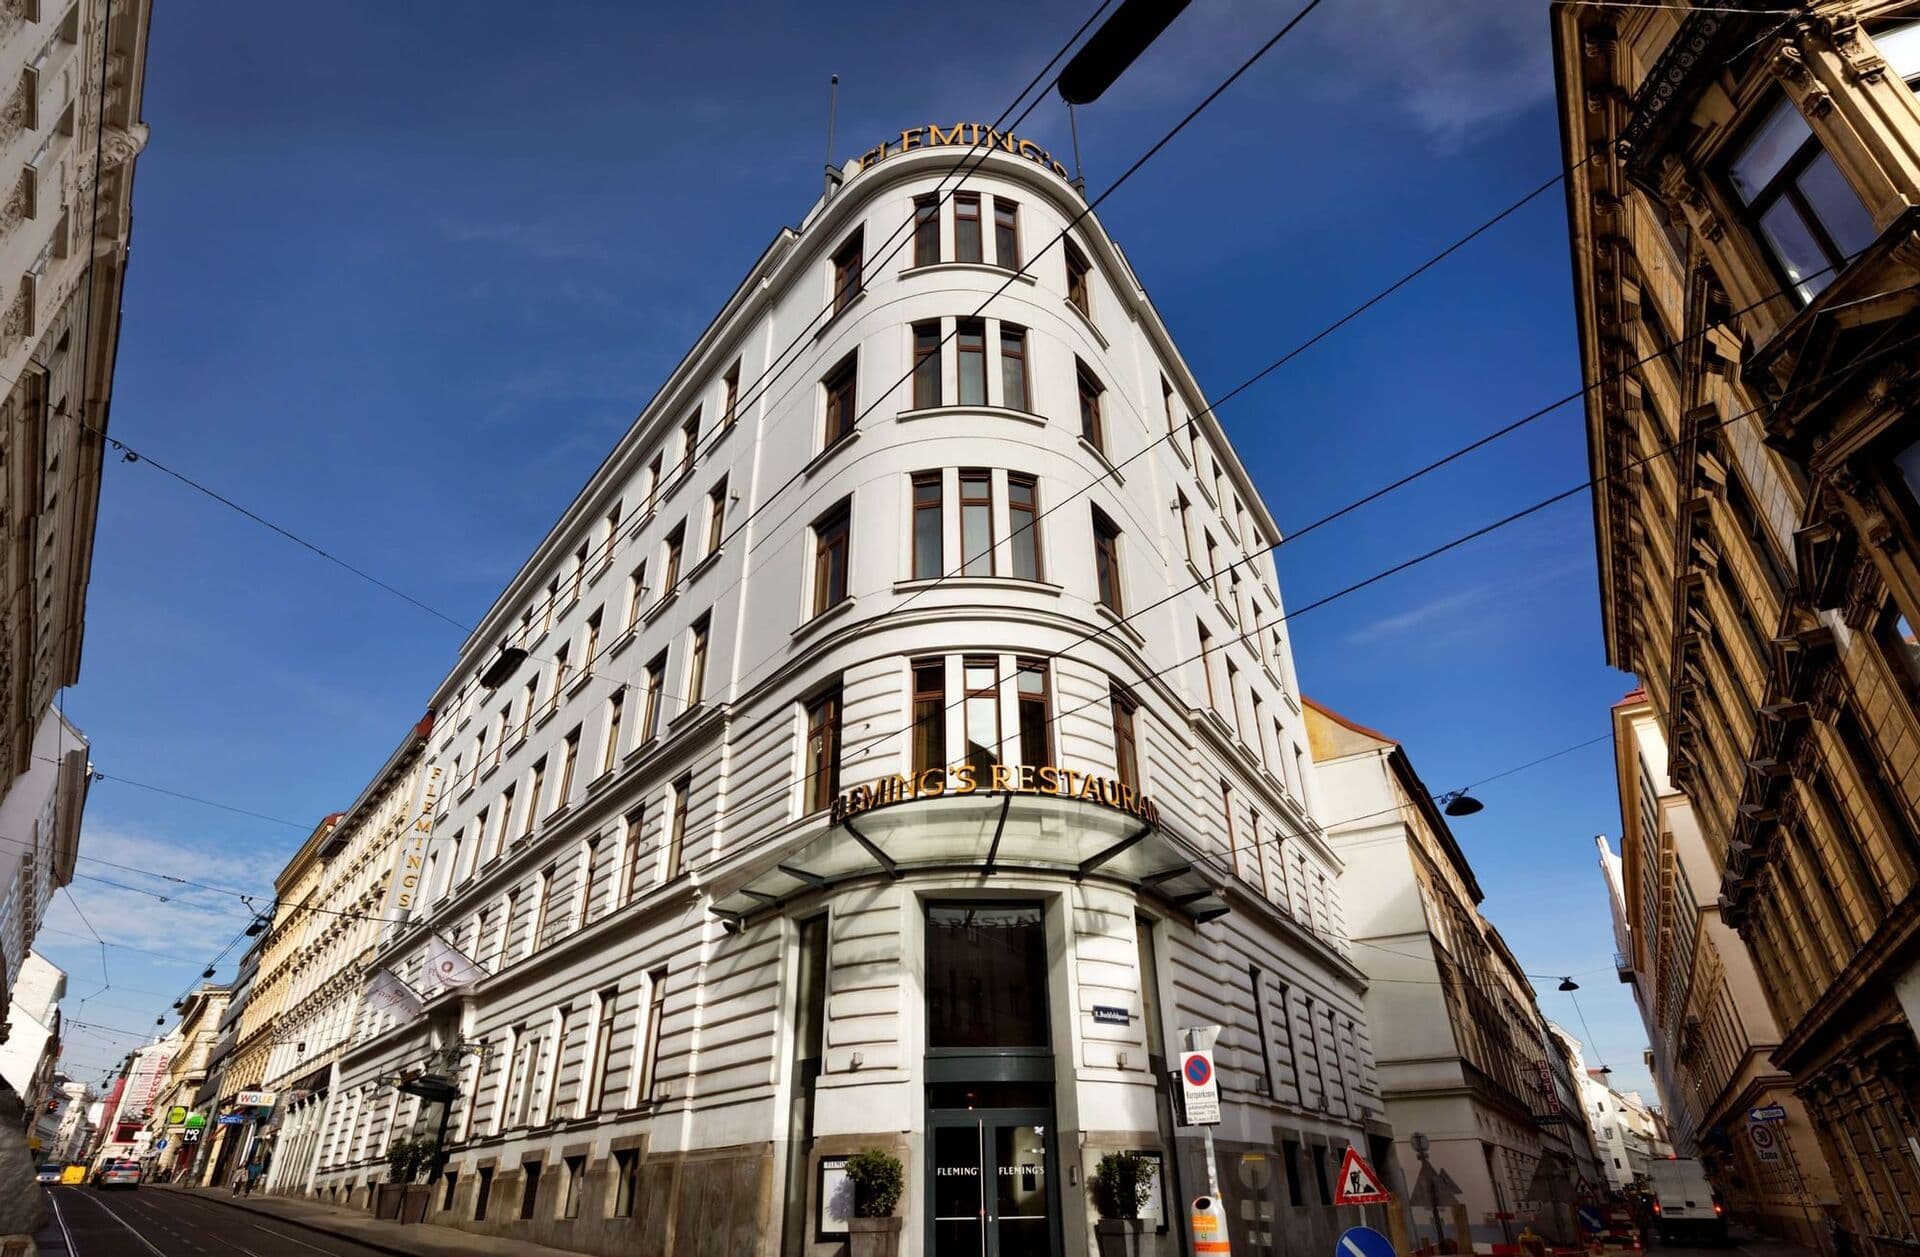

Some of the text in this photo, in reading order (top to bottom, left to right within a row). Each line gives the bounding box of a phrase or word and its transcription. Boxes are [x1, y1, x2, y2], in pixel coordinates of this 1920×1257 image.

[990, 764, 1160, 829] RESTAURAN
[1537, 1061, 1559, 1114] HOTEL
[998, 1166, 1045, 1176] FLEMING'S
